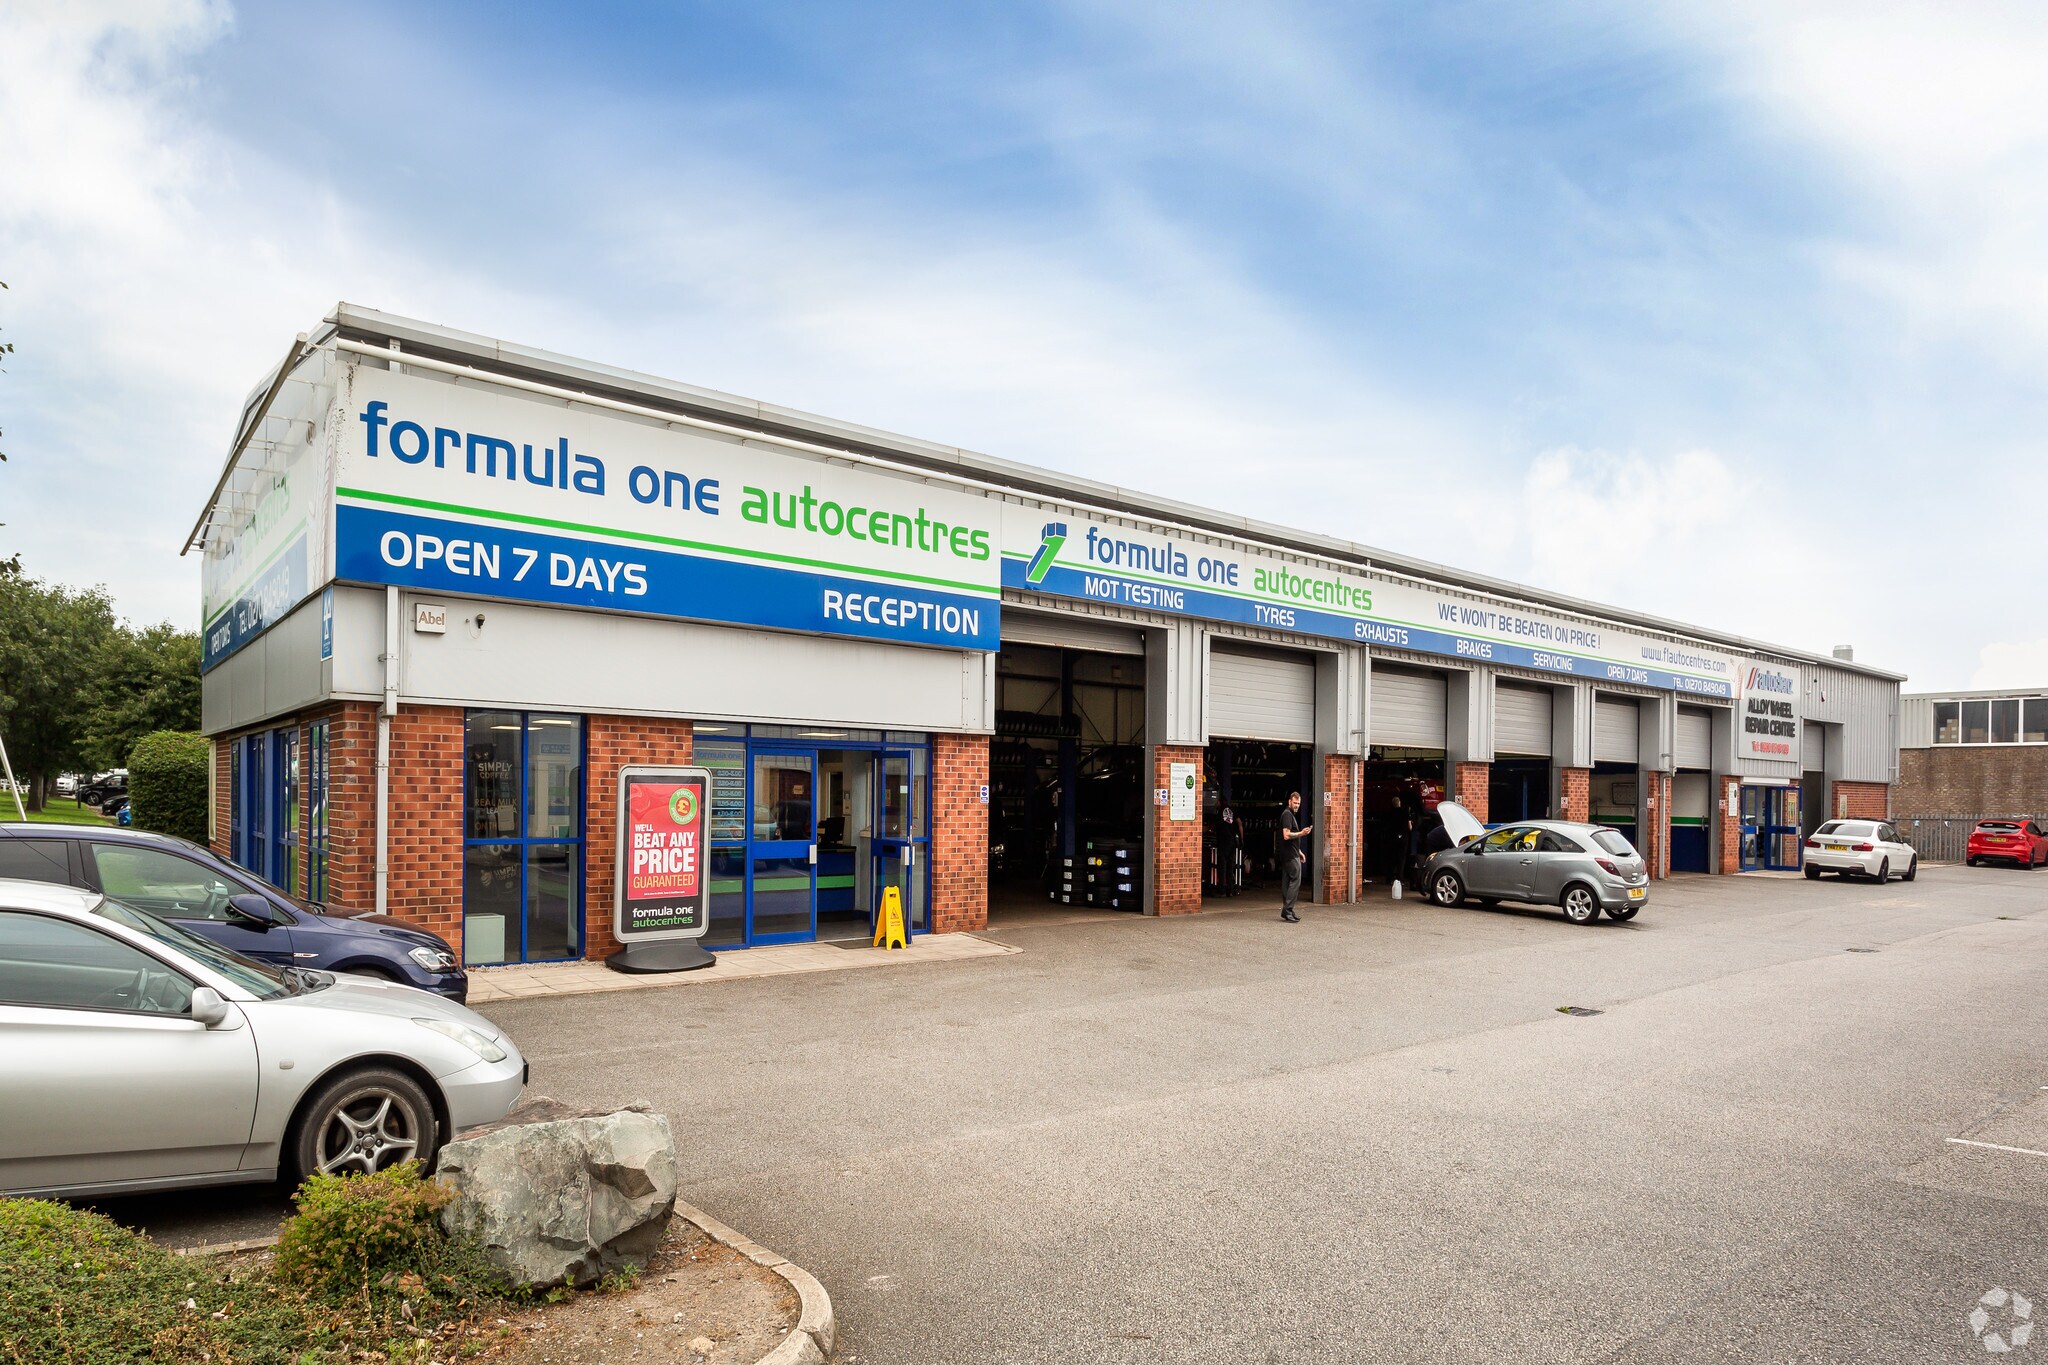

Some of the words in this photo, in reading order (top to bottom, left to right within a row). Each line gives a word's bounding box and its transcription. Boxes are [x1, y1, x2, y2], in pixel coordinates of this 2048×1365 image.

[359, 400, 605, 496] formula
[628, 465, 719, 515] one
[741, 485, 990, 561] autocentres
[380, 530, 500, 579] OPEN
[512, 547, 538, 582] 7
[549, 553, 648, 596] DAYS
[1086, 526, 1188, 578] formula
[1198, 556, 1239, 587] one
[1254, 565, 1373, 611] autocentres
[1085, 576, 1118, 599] MOT
[1122, 579, 1184, 610] TESTING
[418, 611, 445, 625] Abel
[823, 589, 979, 636] RECEPTION
[1254, 604, 1296, 627] TYRES
[1354, 621, 1409, 645] EXHAUSTS
[1438, 602, 1457, 623] WE
[1459, 606, 1497, 630] WON'T
[1499, 614, 1513, 633] BE
[1515, 618, 1553, 640] BEATEN
[1555, 626, 1569, 644] ON
[1570, 630, 1597, 649] PRICE
[1456, 639, 1492, 658] BRAKES
[1533, 652, 1573, 671] SERVICING
[1607, 664, 1625, 680] OPEN
[1625, 667, 1631, 679] 7
[1631, 669, 1648, 684] DAYS
[1685, 678, 1702, 692] 01270
[1703, 681, 1726, 696] 849049
[1748, 697, 1770, 715] ALLOY
[1770, 700, 1793, 718] WHEEL
[1745, 716, 1769, 734] REPAIR
[1770, 719, 1795, 737] CENTRE
[474, 798, 496, 807] REAL
[497, 798, 517, 806] MILK
[676, 790, 693, 801] PRICE
[671, 807, 694, 822] PROMISE
[635, 824, 654, 832] WE'LL
[634, 832, 667, 848] BEAT
[669, 832, 695, 847] ANY
[633, 848, 695, 875] PRICE
[633, 873, 695, 889] GUARANTEED
[632, 915, 693, 928] autocentres
[633, 906, 672, 919] formula
[675, 905, 693, 915] one
